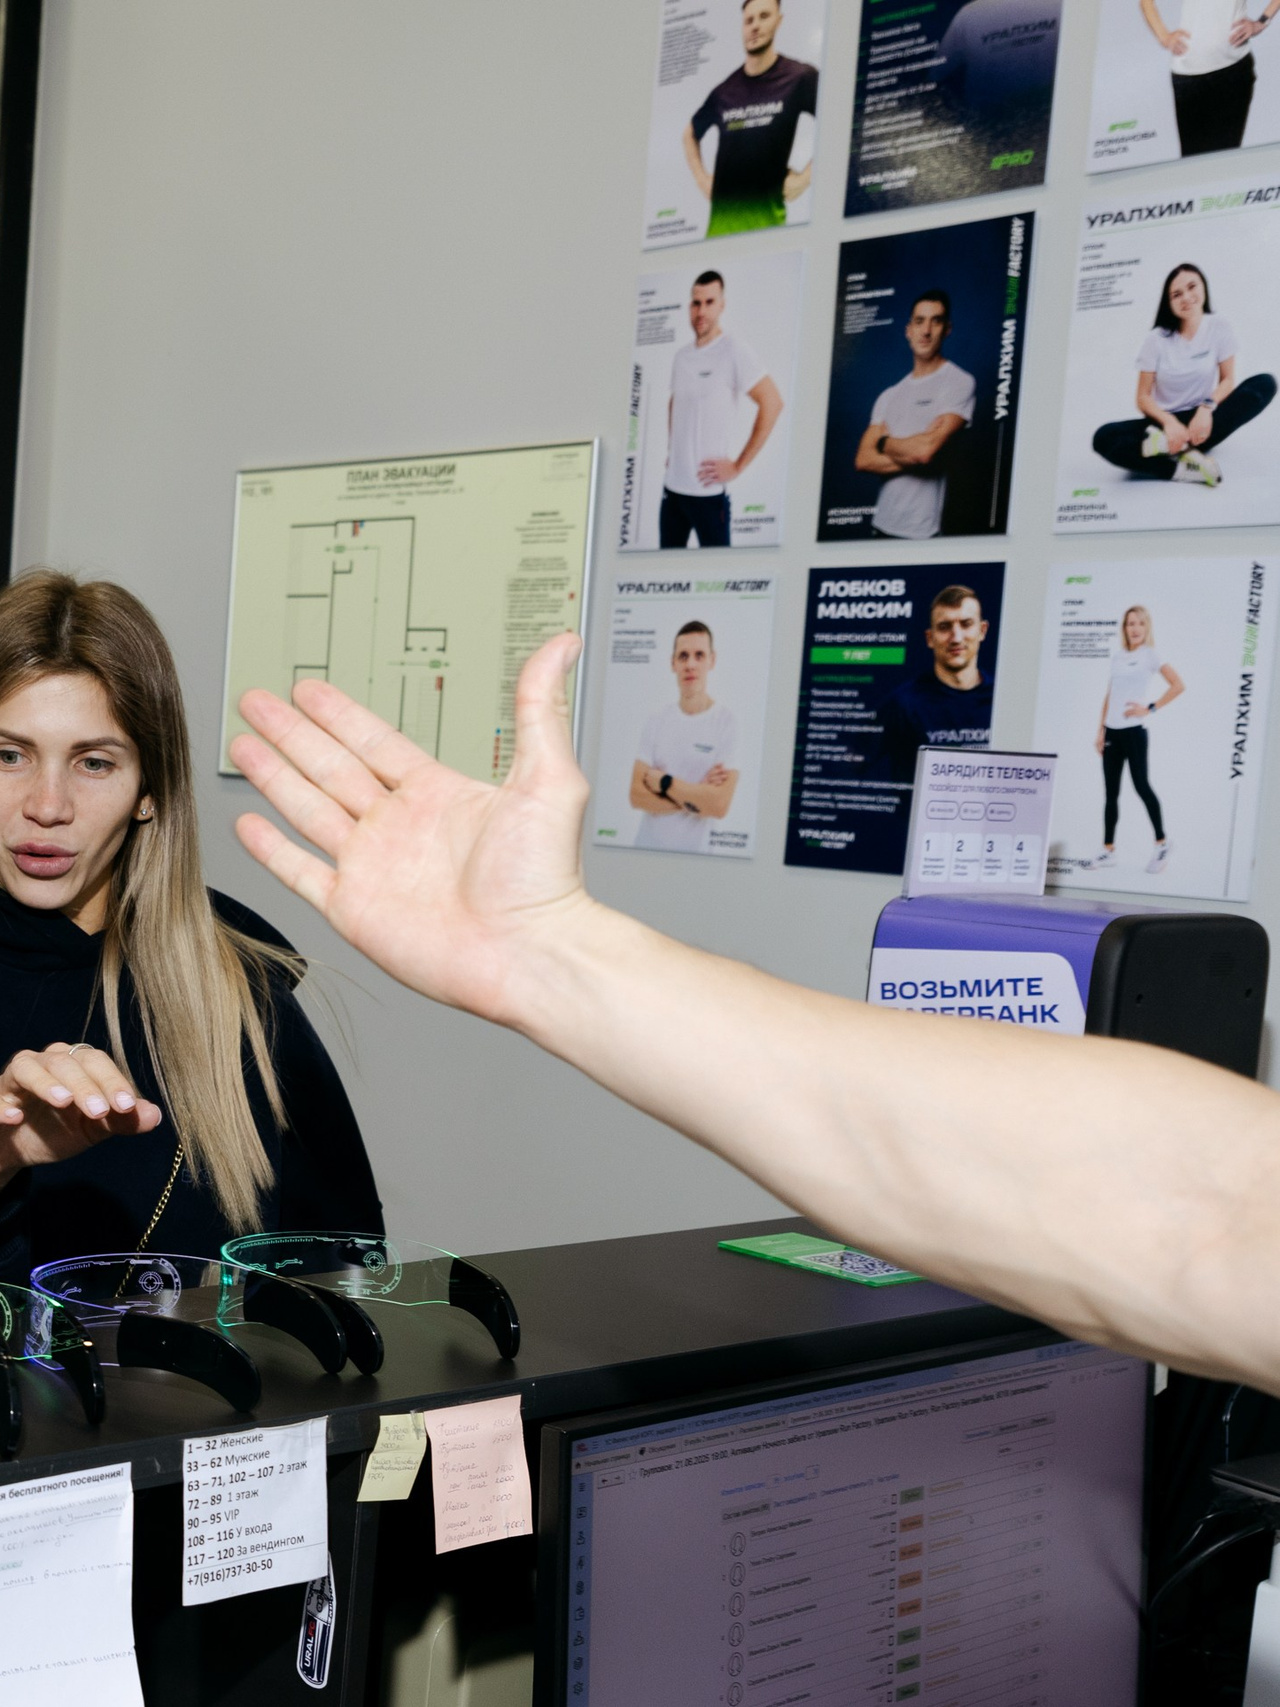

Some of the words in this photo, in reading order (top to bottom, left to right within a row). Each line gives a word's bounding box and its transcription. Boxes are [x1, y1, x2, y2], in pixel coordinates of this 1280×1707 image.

[1086, 199, 1195, 229] УРАЛХИМ
[995, 319, 1017, 420] УРАЛХИМ
[347, 470, 380, 484] ПЛАН
[382, 464, 456, 482] ЭВАКУАЦИИ
[620, 456, 636, 547] УРАЛХИМ
[1056, 513, 1118, 523] ЕКАТЕРИНА
[617, 581, 691, 594] УРАЛХИМ
[818, 579, 906, 598] ЛОБКОВ
[817, 602, 913, 619] МАКСИМ
[814, 632, 877, 643] ТРЕНЕРСКИЙ
[879, 633, 907, 643] СТАЖ
[926, 727, 990, 743] УРАЛХИ
[1229, 672, 1254, 781] УРАЛХИМ
[931, 764, 993, 779] ЗАРЯДИТЕ
[997, 767, 1051, 781] ТЕЛЕФОН
[956, 841, 964, 852] 2
[986, 841, 994, 853] 3
[1016, 841, 1024, 853] 4
[880, 977, 1043, 1000] ВОЗЬМИТЕ
[886, 1004, 1060, 1024] РБАНК
[187, 1443, 193, 1454] 1
[205, 1440, 217, 1451] 32
[219, 1433, 264, 1449] Женские
[186, 1461, 199, 1473] 33
[210, 1457, 222, 1468] 62
[225, 1450, 270, 1467] Мужские
[8, 1480, 68, 1500] бесплатного
[70, 1467, 124, 1487] посещения!
[187, 1480, 200, 1492] 63
[211, 1476, 226, 1488] 71,
[229, 1471, 246, 1484] 102
[257, 1466, 274, 1479] 107
[278, 1463, 284, 1475] 2
[286, 1460, 308, 1473] этаж
[187, 1500, 200, 1511] 72
[210, 1494, 222, 1506] 89
[227, 1492, 233, 1502] 1
[235, 1488, 260, 1501] этаж
[187, 1518, 200, 1530] 90
[210, 1513, 222, 1525] 95
[224, 1508, 240, 1522] VIP
[187, 1535, 205, 1548] 108
[217, 1529, 234, 1543] 116
[235, 1527, 243, 1538] У
[245, 1522, 273, 1537] входа
[187, 1553, 205, 1567] 117
[217, 1548, 234, 1561] 120
[236, 1544, 248, 1556] За
[250, 1535, 305, 1554] вендингом
[187, 1558, 273, 1587] +7(916)737-30-50
